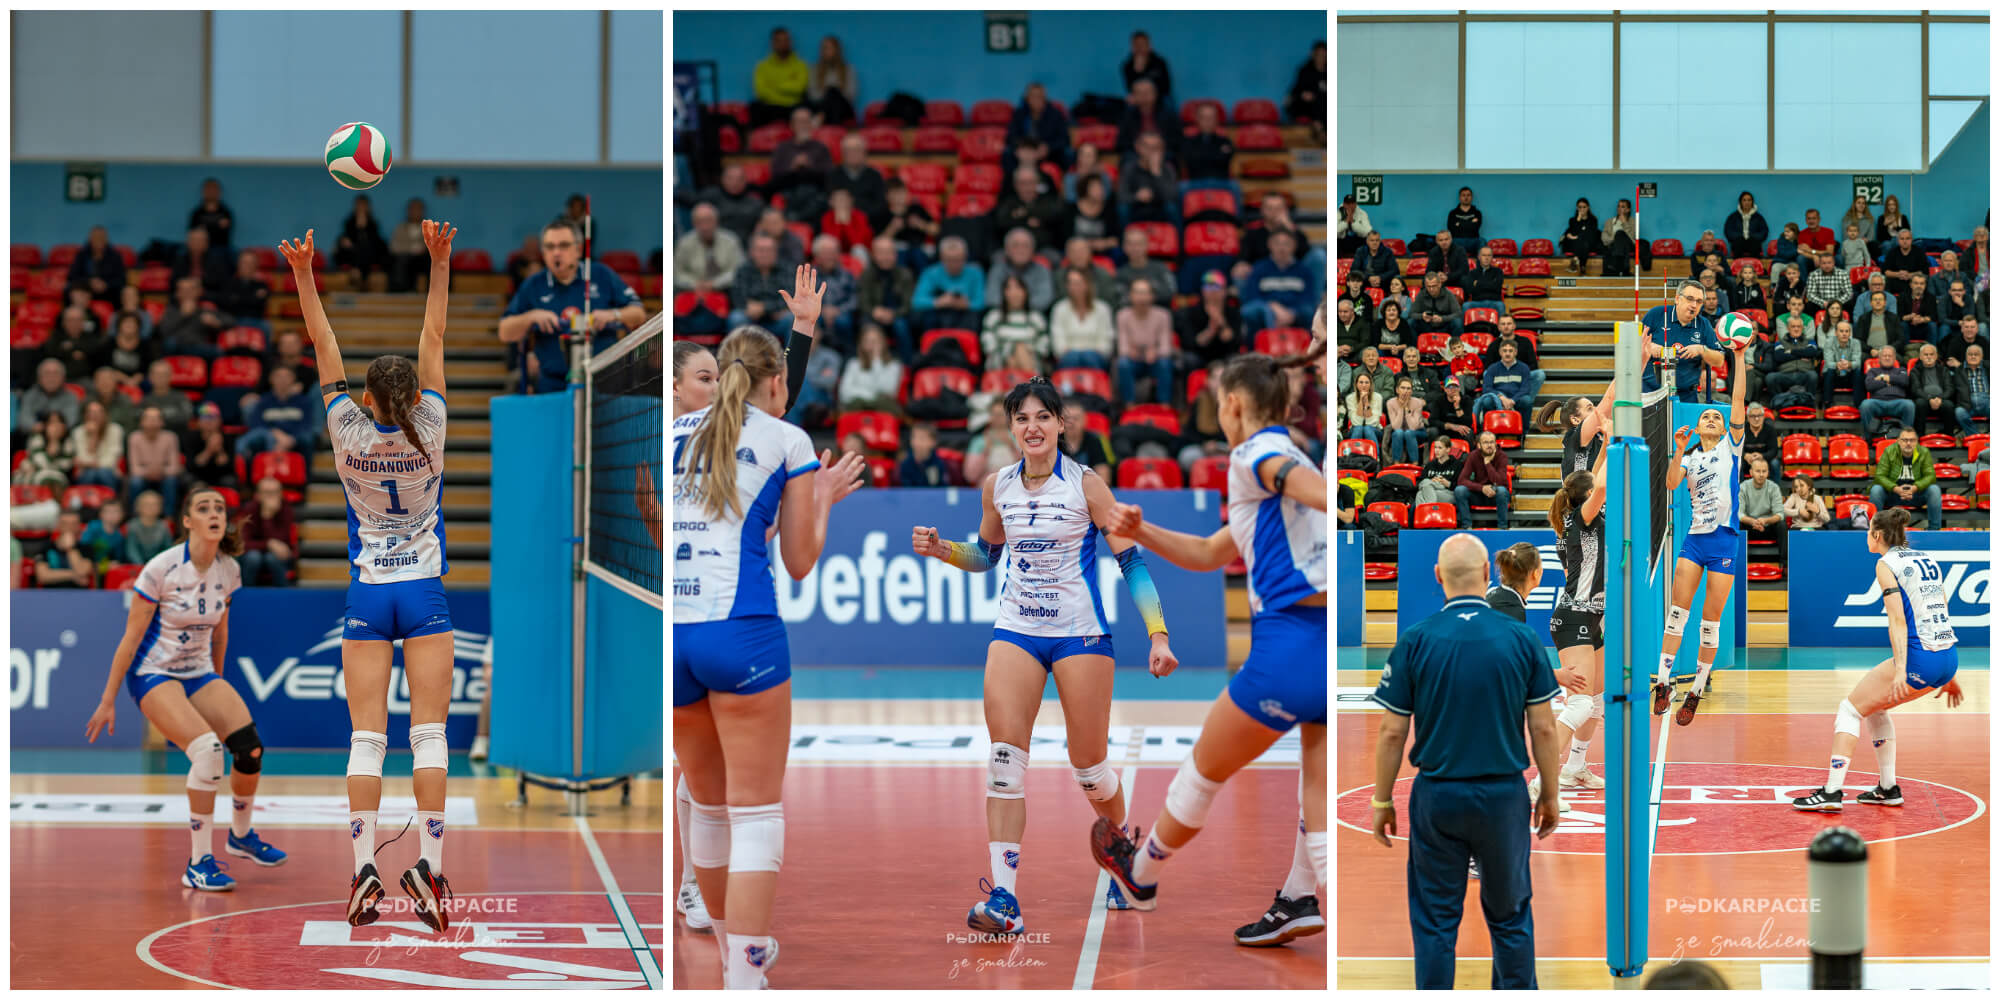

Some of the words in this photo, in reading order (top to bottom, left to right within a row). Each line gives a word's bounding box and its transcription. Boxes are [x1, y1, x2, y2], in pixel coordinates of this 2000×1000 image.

[988, 24, 1025, 49] B1
[69, 175, 102, 199] B1
[1356, 186, 1379, 202] B1
[380, 480, 408, 514] 1
[374, 555, 419, 567] PORTIUS
[1913, 558, 1939, 581] 15
[198, 598, 206, 615] 8
